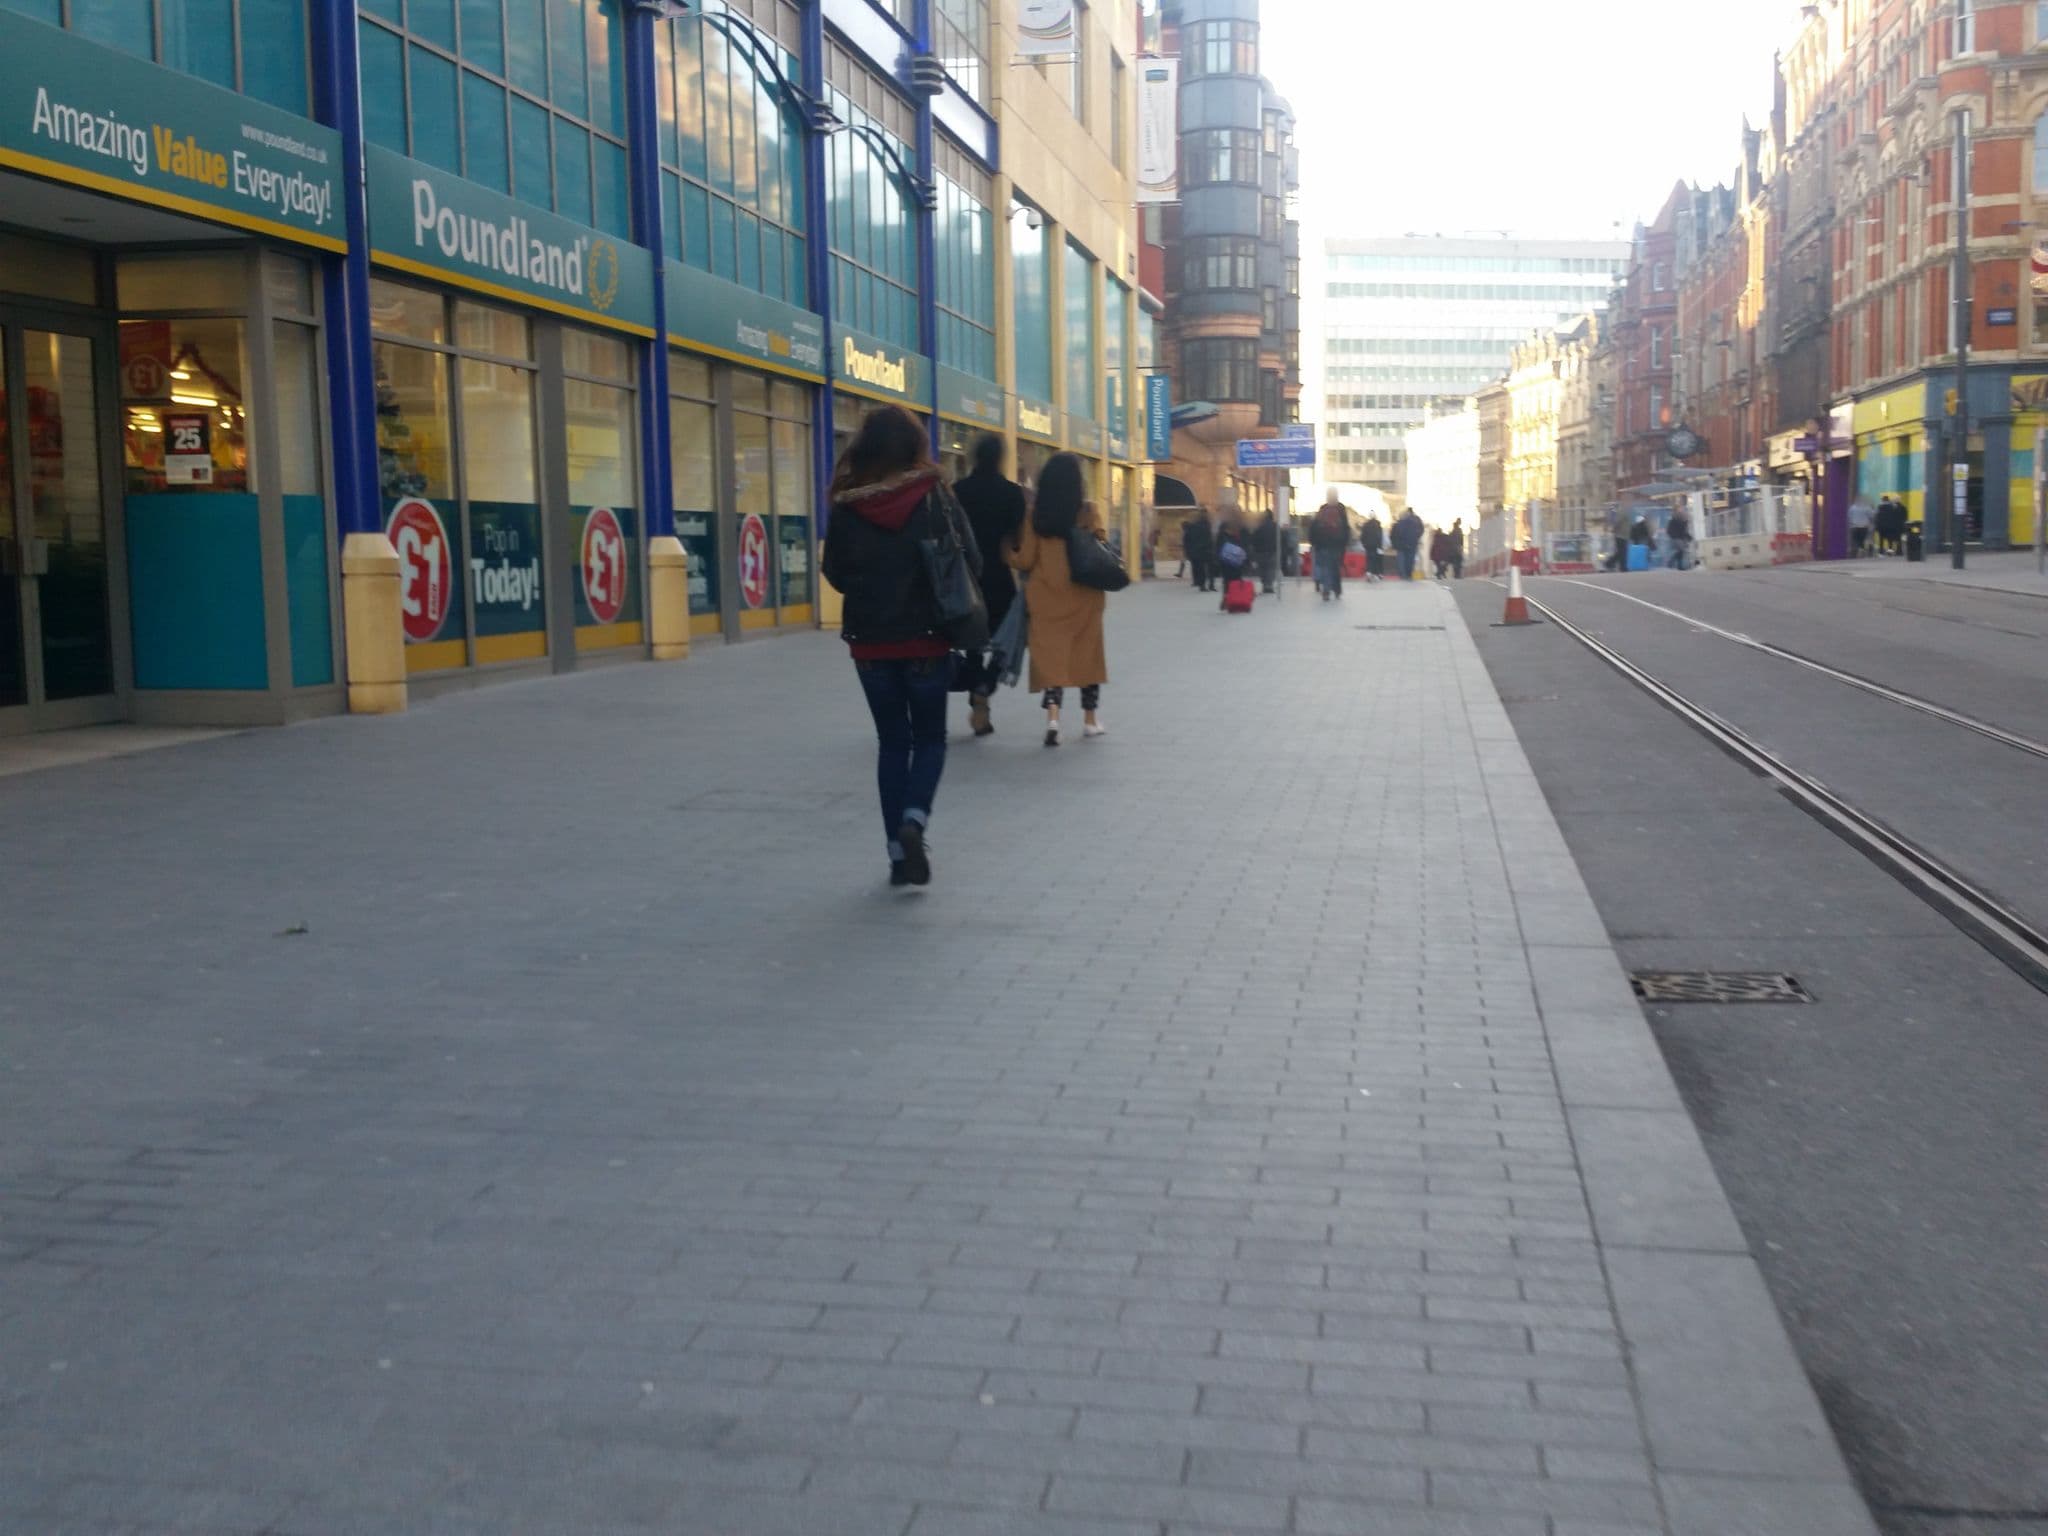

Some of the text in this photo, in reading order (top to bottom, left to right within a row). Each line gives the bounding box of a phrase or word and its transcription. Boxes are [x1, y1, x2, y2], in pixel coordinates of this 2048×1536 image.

[32, 86, 332, 225] Amazing Value Everyday!
[412, 179, 584, 296] Poundland
[844, 336, 905, 393] Poundland
[173, 427, 201, 450] 25
[1152, 378, 1165, 441] Poundland
[484, 523, 507, 556] Pop
[589, 528, 620, 607] £1
[743, 531, 766, 596] £1
[397, 525, 440, 621] £1
[471, 557, 540, 611] Today!
